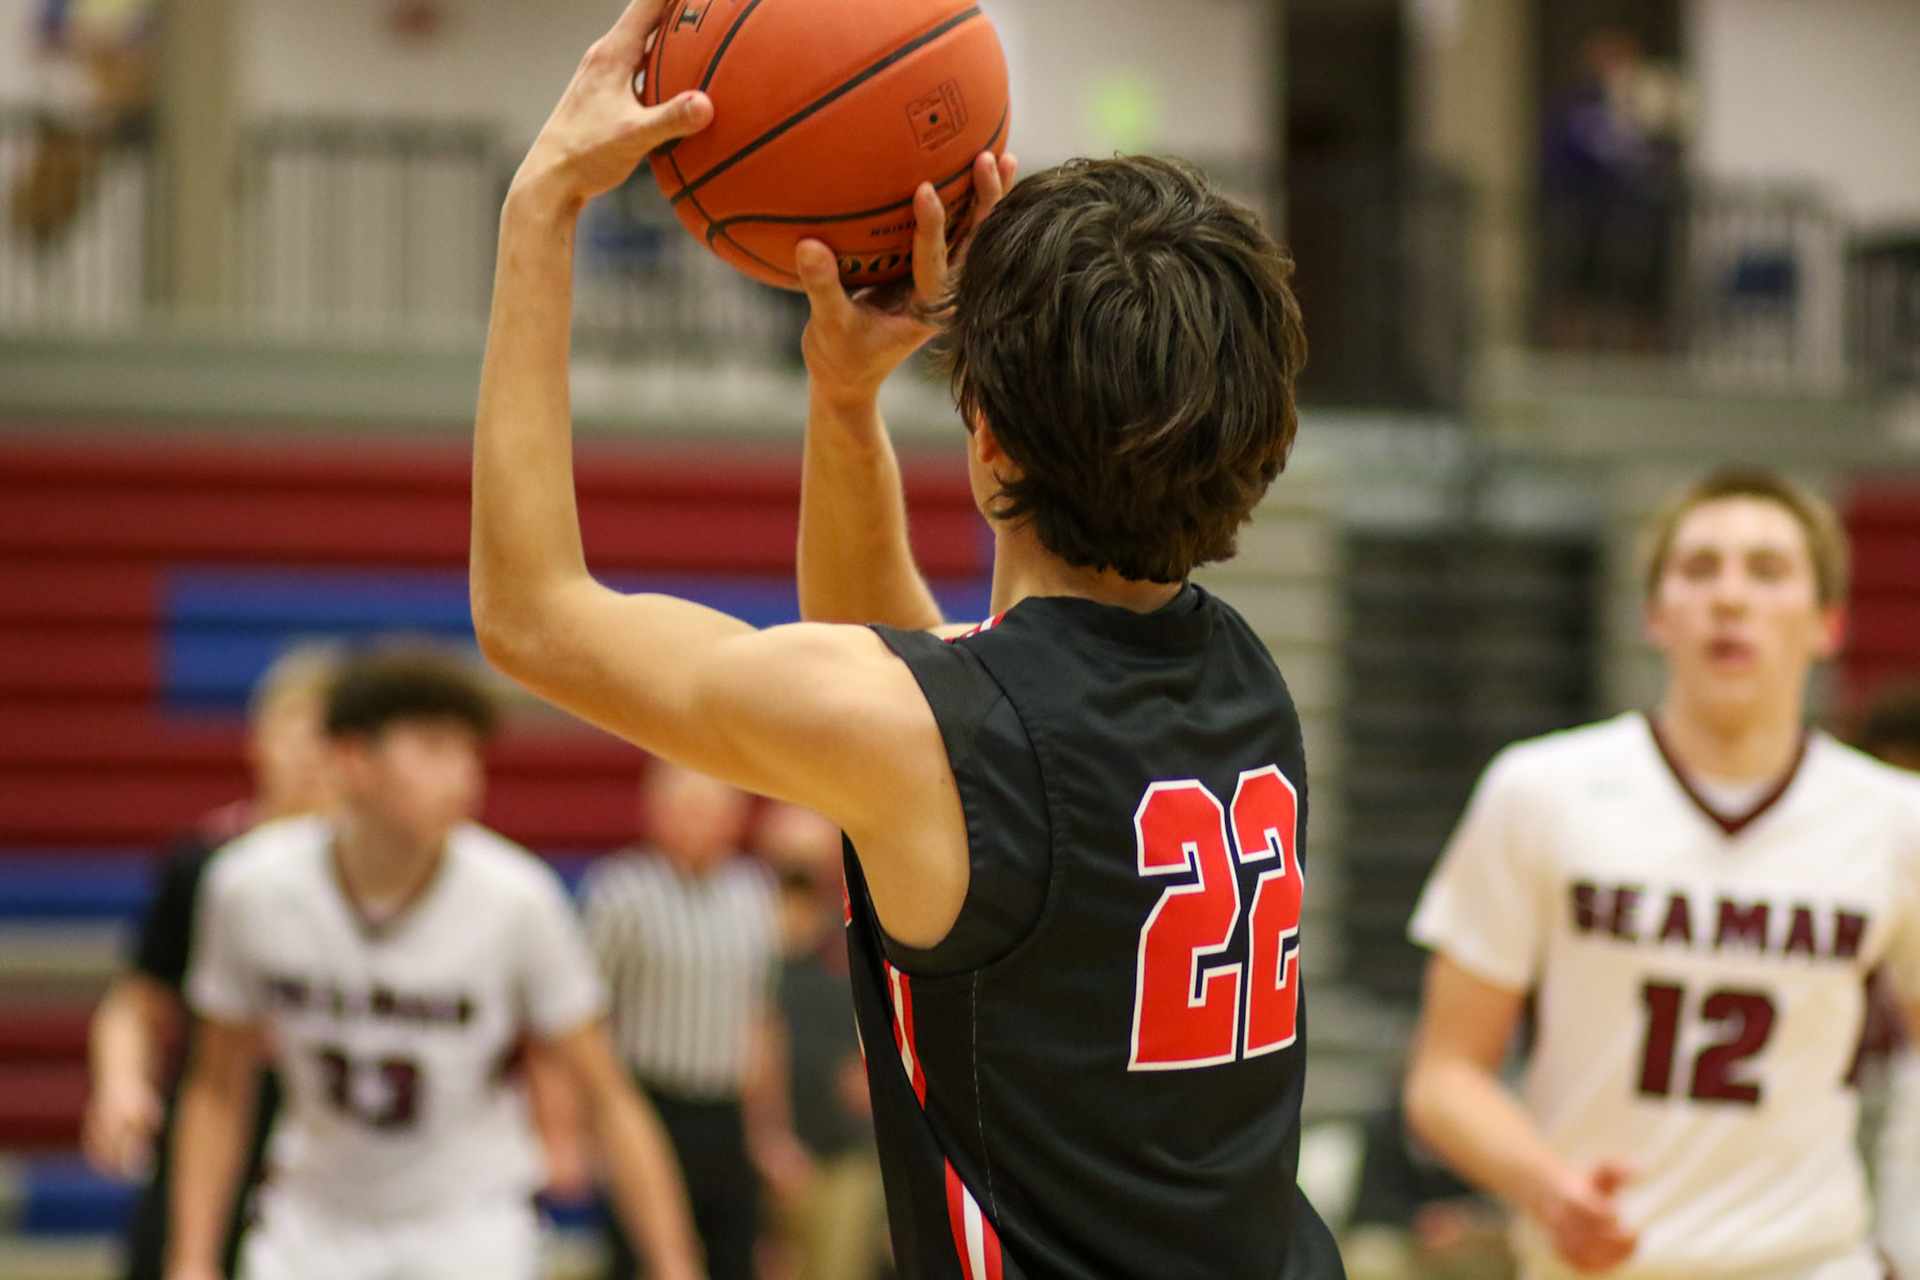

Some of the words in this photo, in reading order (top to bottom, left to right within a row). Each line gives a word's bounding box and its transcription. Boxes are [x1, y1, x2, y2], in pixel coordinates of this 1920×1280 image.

[1127, 763, 1304, 1072] 22
[1570, 880, 1868, 960] SEAMAN
[1636, 980, 1776, 1106] 12
